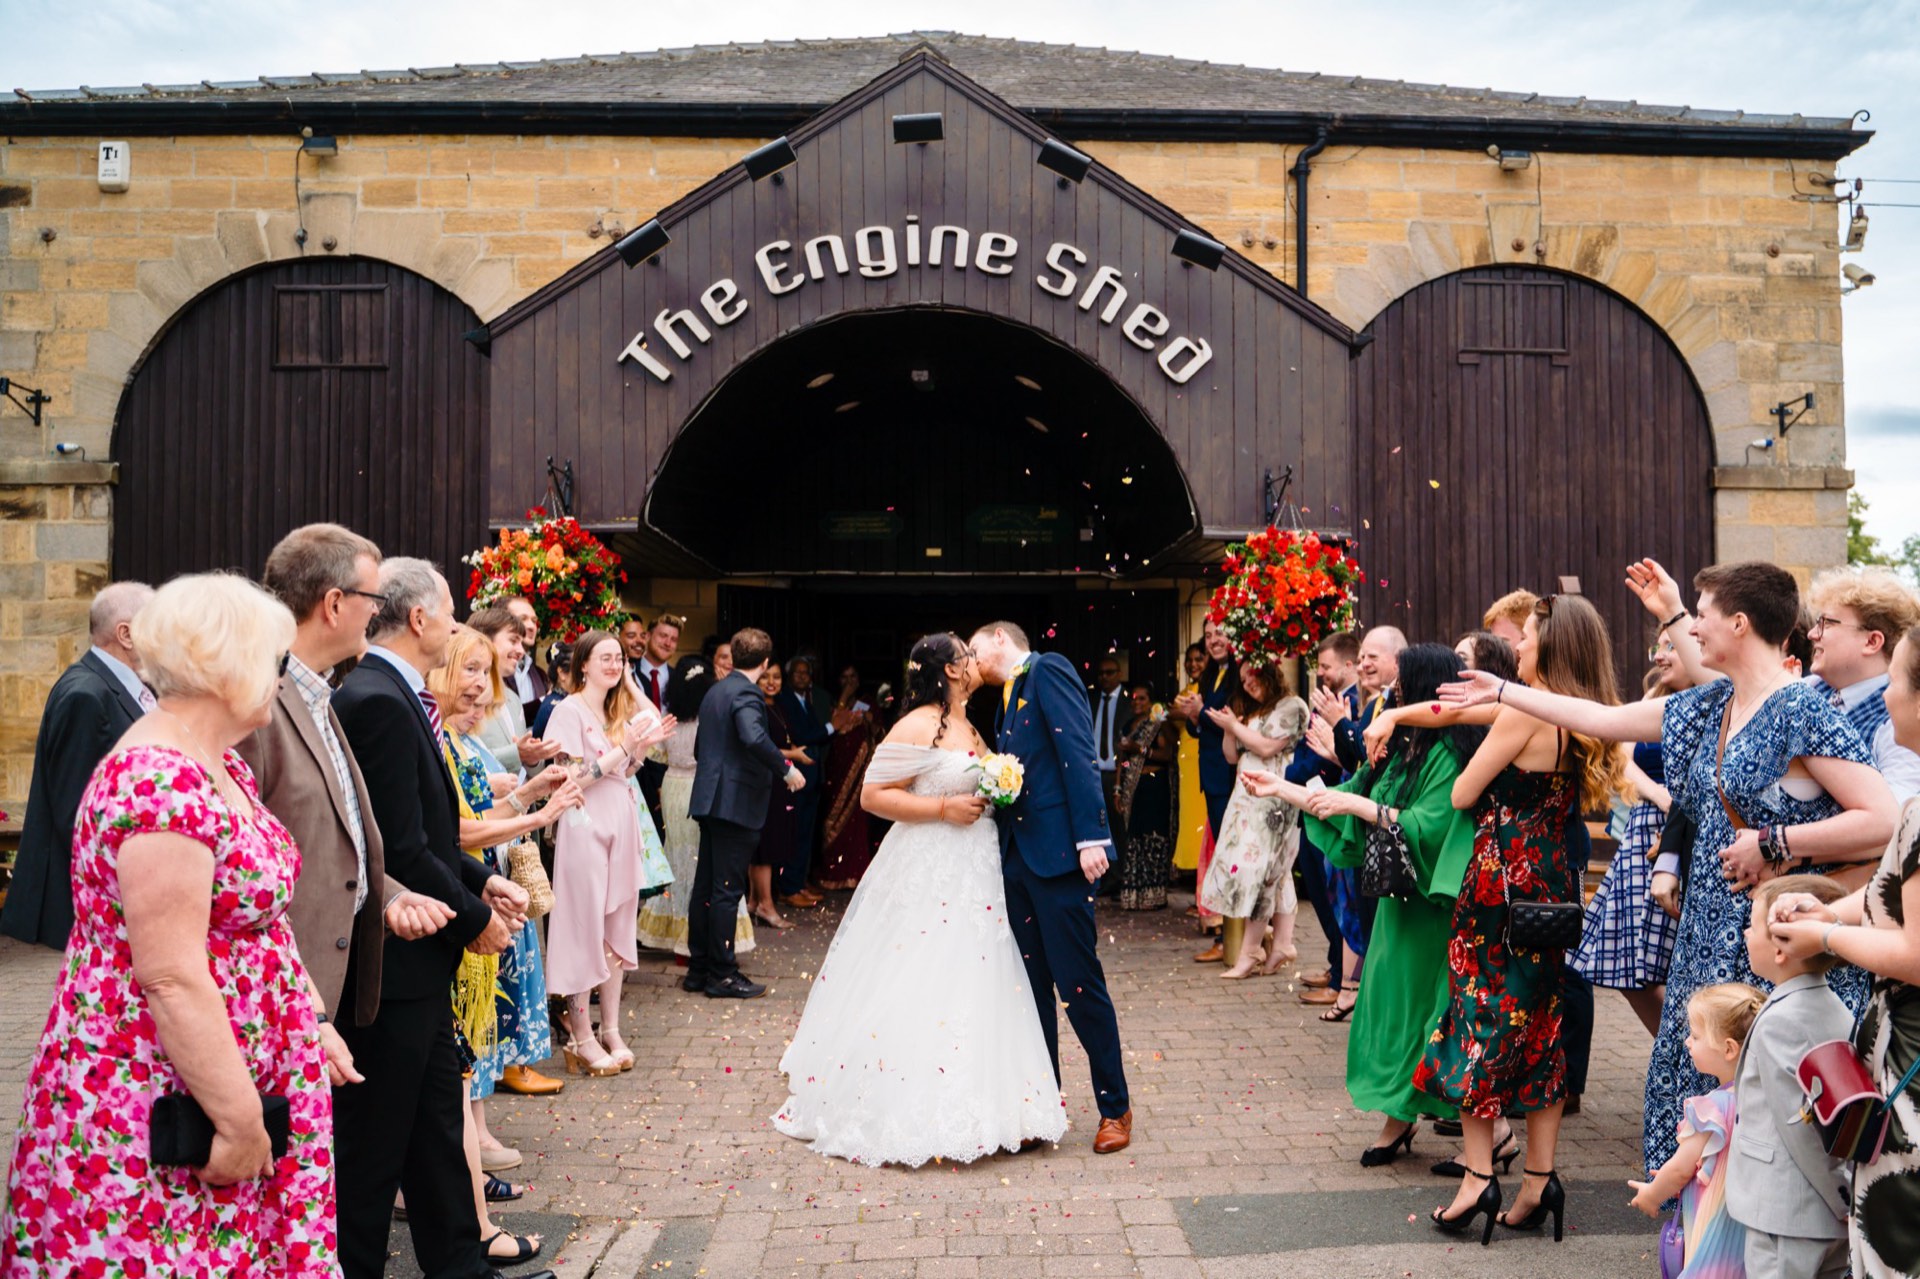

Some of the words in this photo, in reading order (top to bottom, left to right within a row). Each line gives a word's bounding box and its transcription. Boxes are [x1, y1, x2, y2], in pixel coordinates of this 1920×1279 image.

[617, 278, 748, 382] The
[755, 214, 1018, 295] Engine
[1036, 242, 1213, 384] Shed
